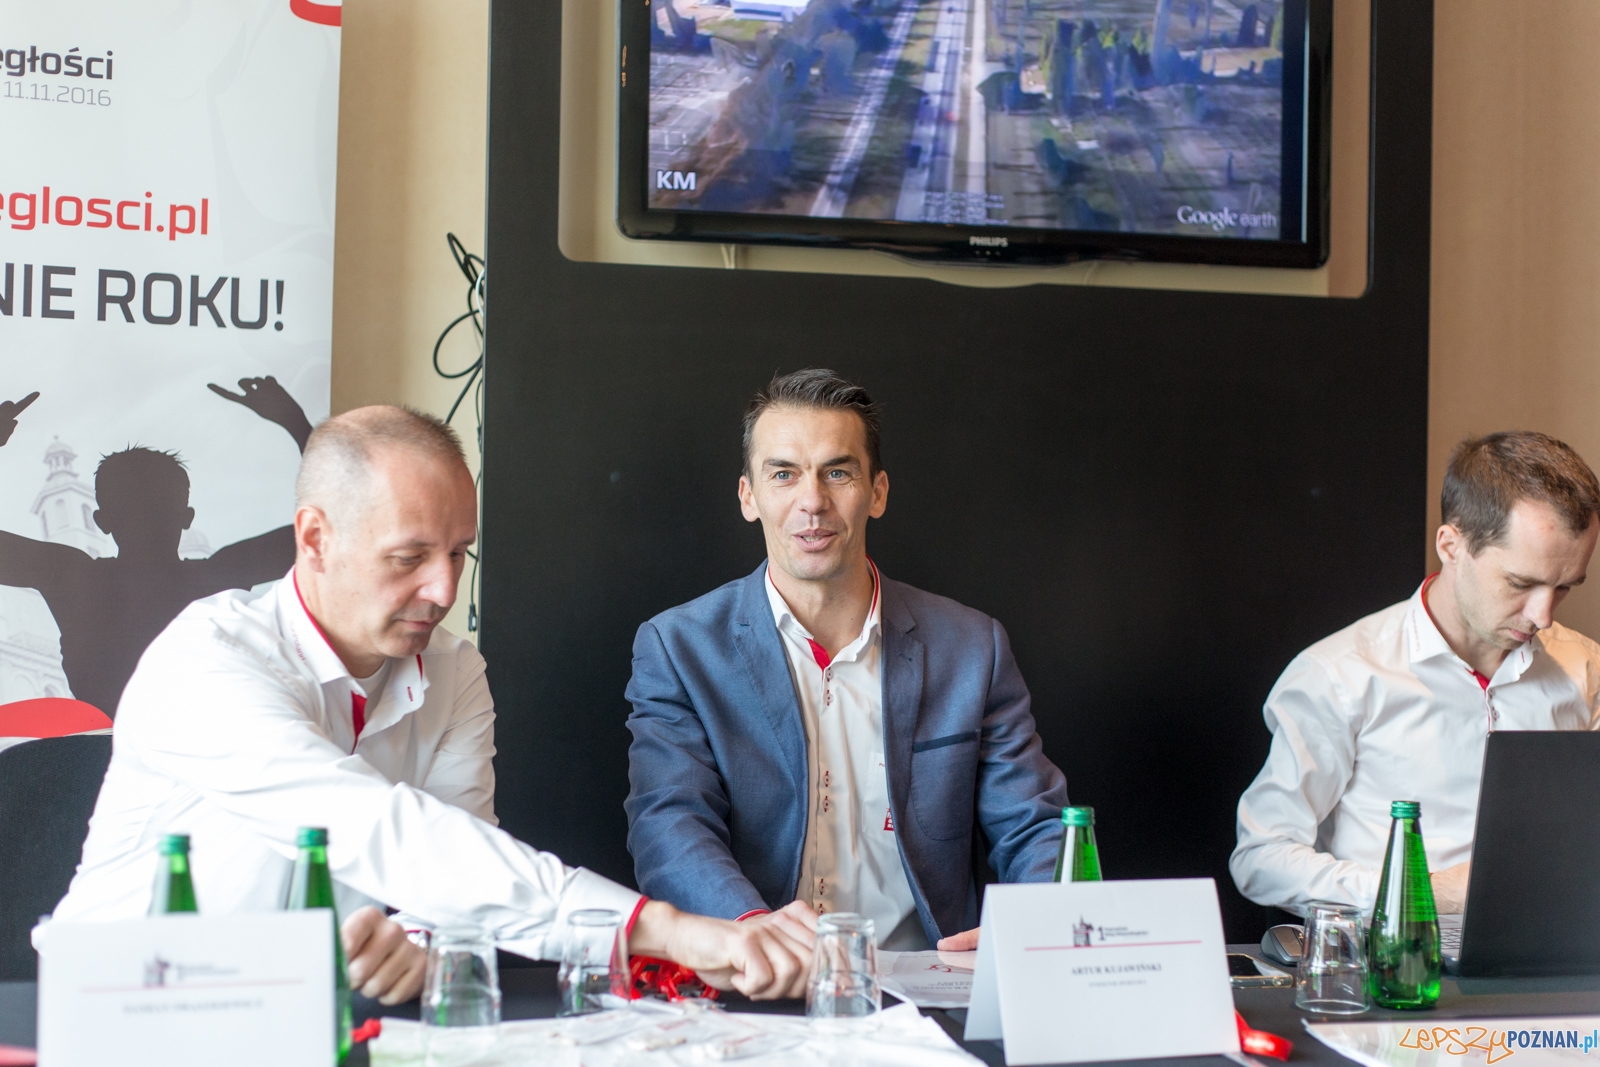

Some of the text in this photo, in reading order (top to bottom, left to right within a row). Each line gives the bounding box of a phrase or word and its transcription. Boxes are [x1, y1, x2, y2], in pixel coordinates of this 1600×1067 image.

[0, 45, 113, 80] głości
[3, 80, 111, 107] 11.11.2016
[656, 170, 696, 191] KM
[0, 186, 209, 241] glosci.pl
[1176, 205, 1278, 232] Google earth
[969, 236, 1009, 248] PHILIPS
[97, 268, 285, 331] ROKU!
